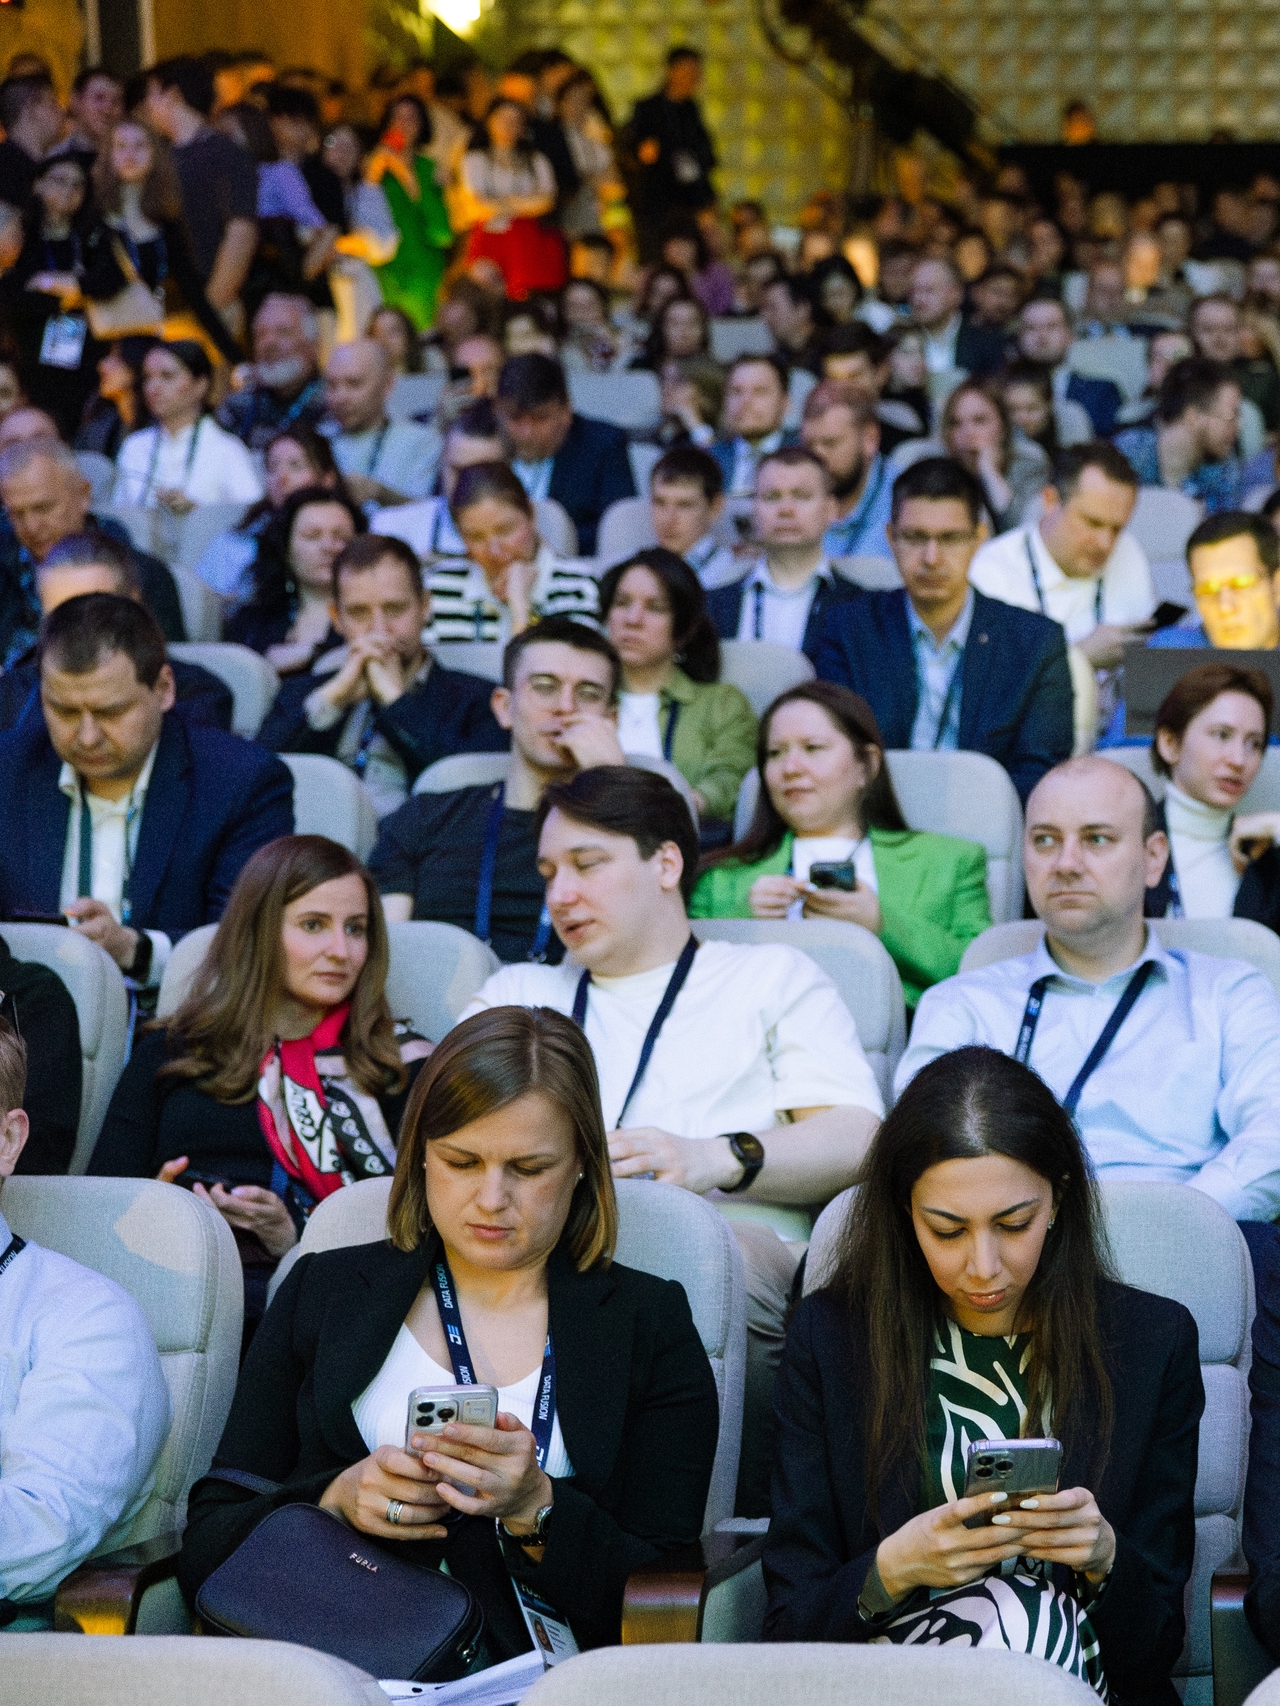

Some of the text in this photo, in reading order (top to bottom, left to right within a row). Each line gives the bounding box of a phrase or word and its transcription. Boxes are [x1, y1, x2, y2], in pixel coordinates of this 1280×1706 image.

[436, 1263, 454, 1309] DATA FUSION
[538, 1374, 552, 1421] DATA FUSION
[350, 1553, 378, 1573] FURLA
